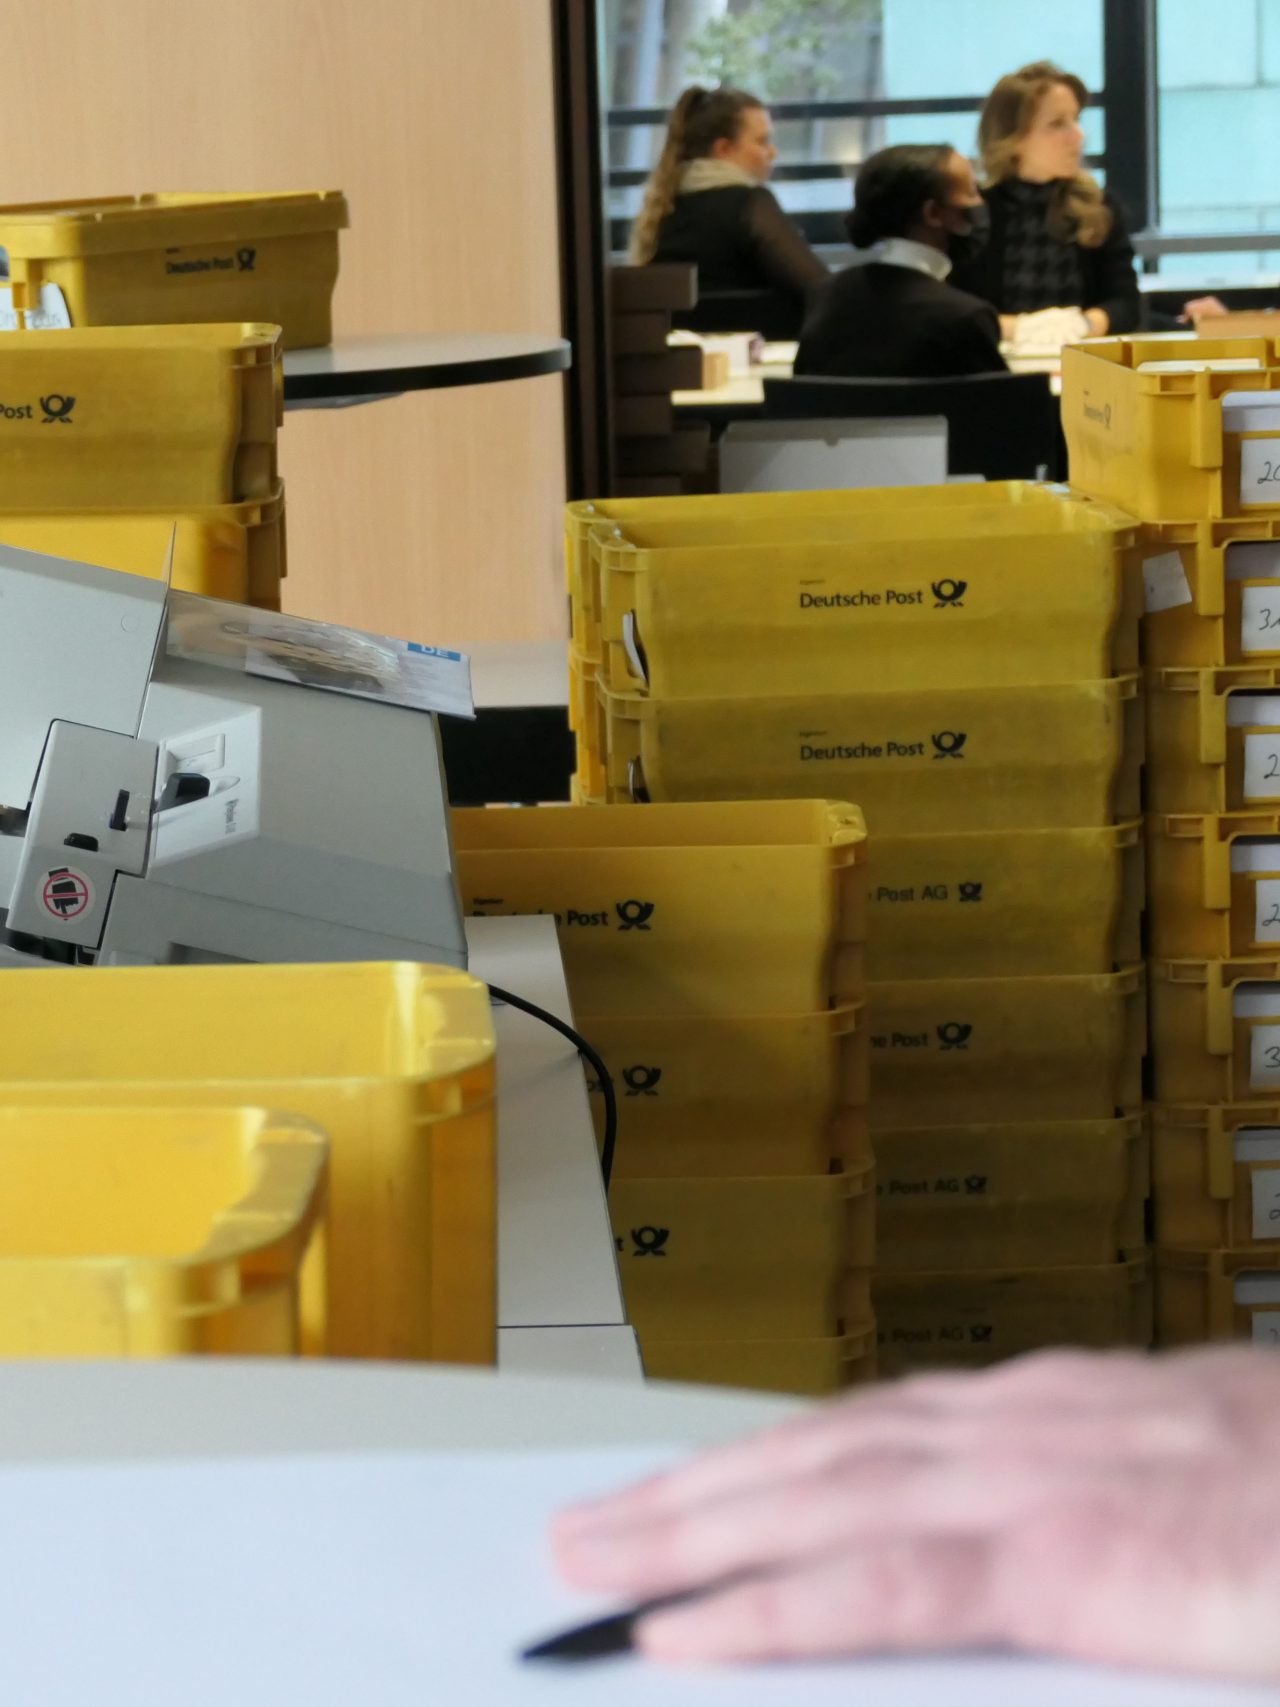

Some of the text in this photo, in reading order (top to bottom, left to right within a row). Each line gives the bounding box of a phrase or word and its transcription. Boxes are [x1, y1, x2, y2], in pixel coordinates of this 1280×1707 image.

[800, 589, 923, 608] Deutsche Post
[800, 742, 924, 760] Deutsche Post
[877, 886, 914, 901] Post
[921, 884, 948, 900] AG
[567, 910, 608, 926] Post
[891, 1032, 929, 1047] Post
